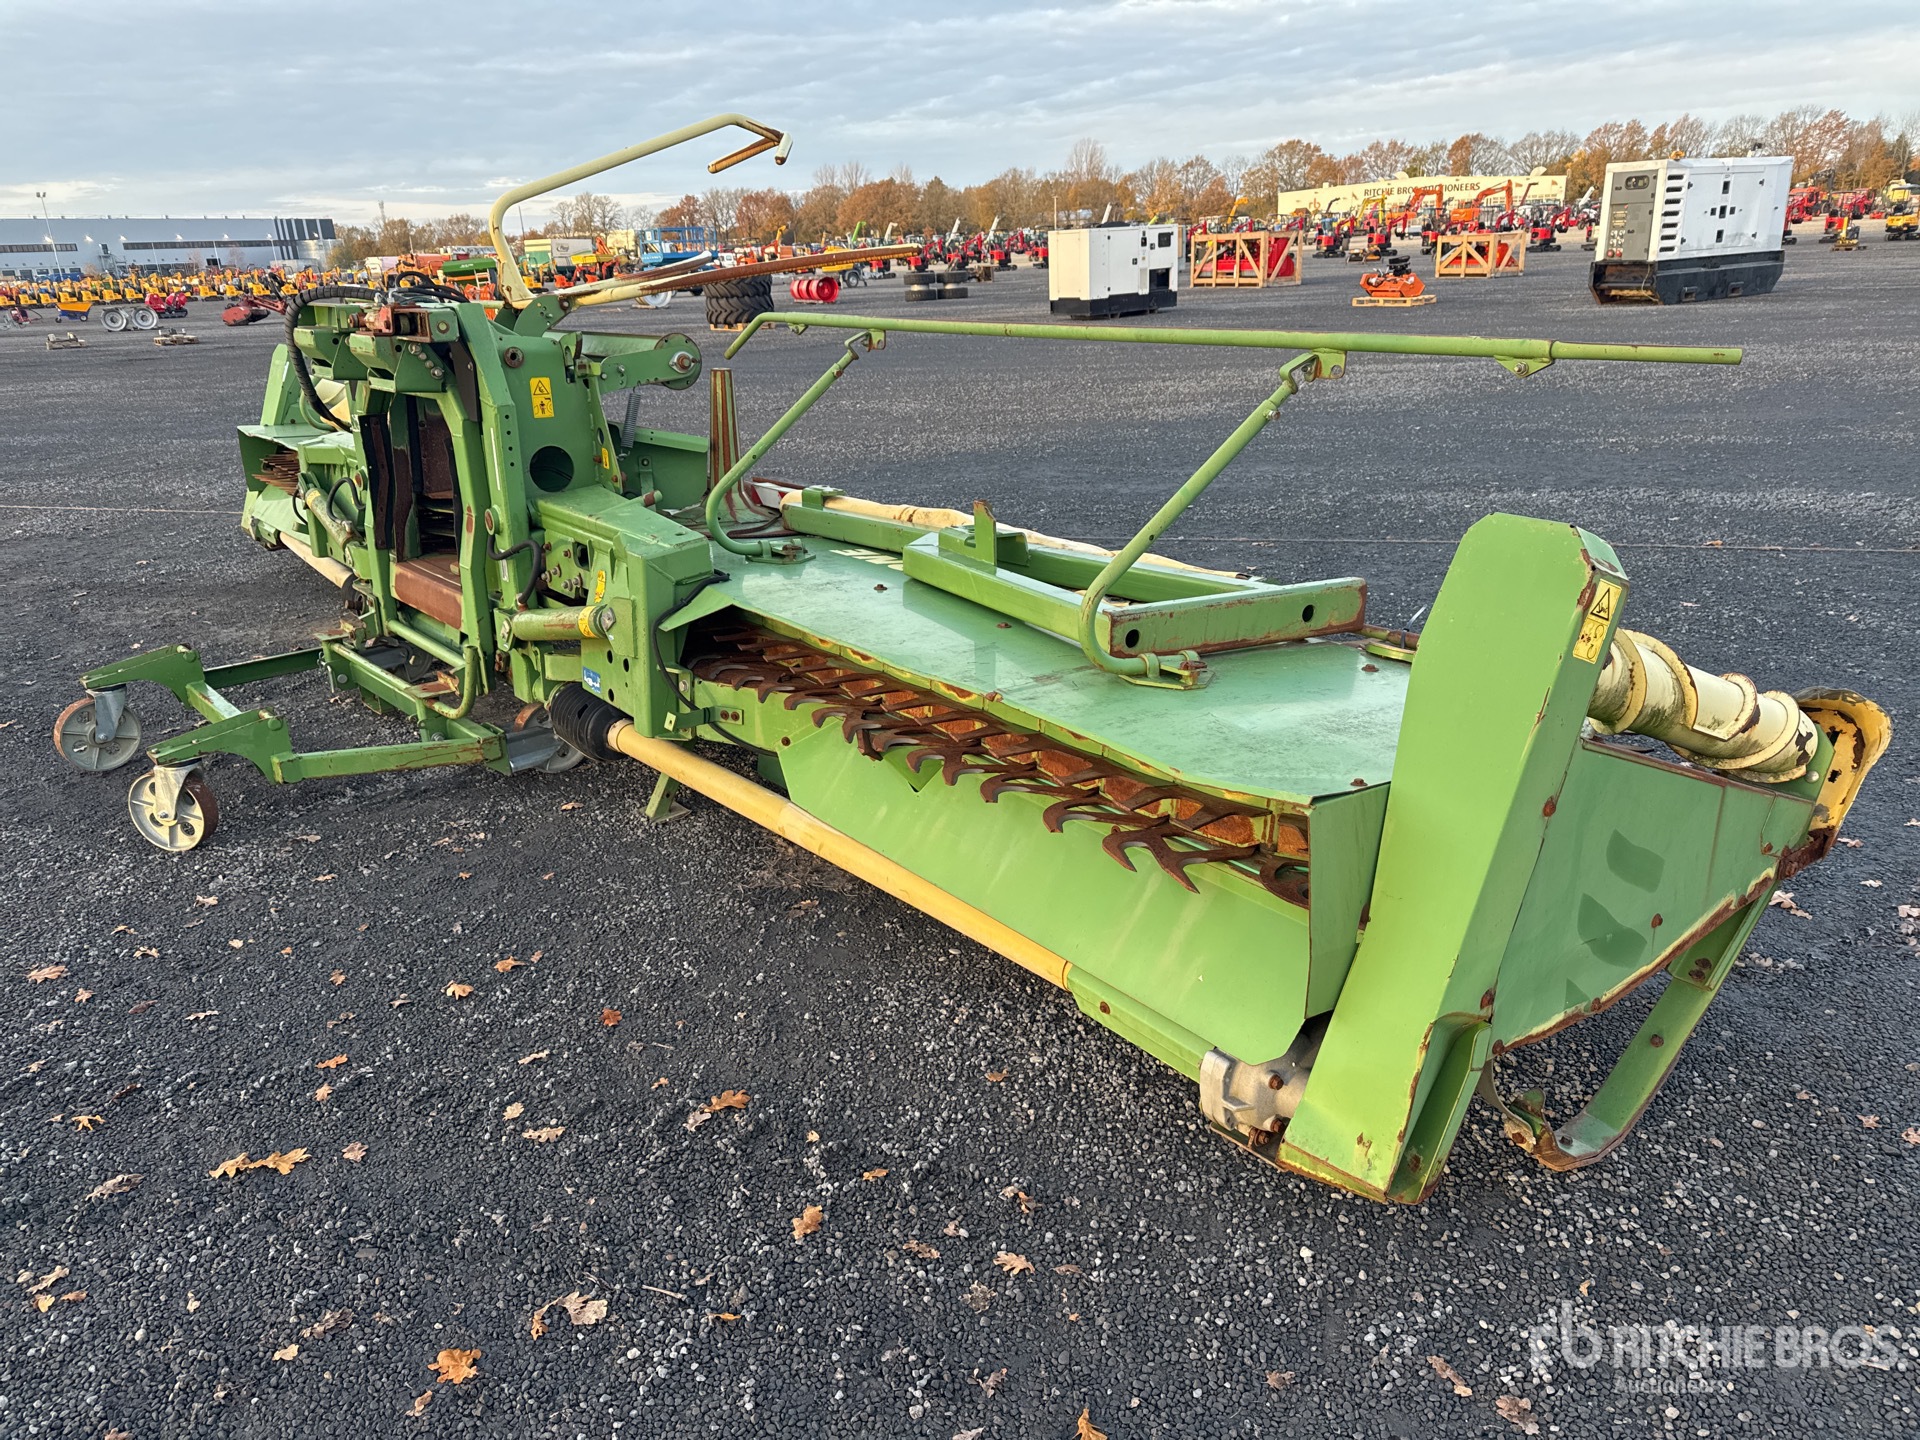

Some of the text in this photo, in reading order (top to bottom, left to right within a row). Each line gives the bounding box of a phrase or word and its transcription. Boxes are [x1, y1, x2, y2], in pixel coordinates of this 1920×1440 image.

[1364, 187, 1394, 197] RITCHIE
[1397, 186, 1417, 195] BRO
[1308, 197, 1321, 209] rb
